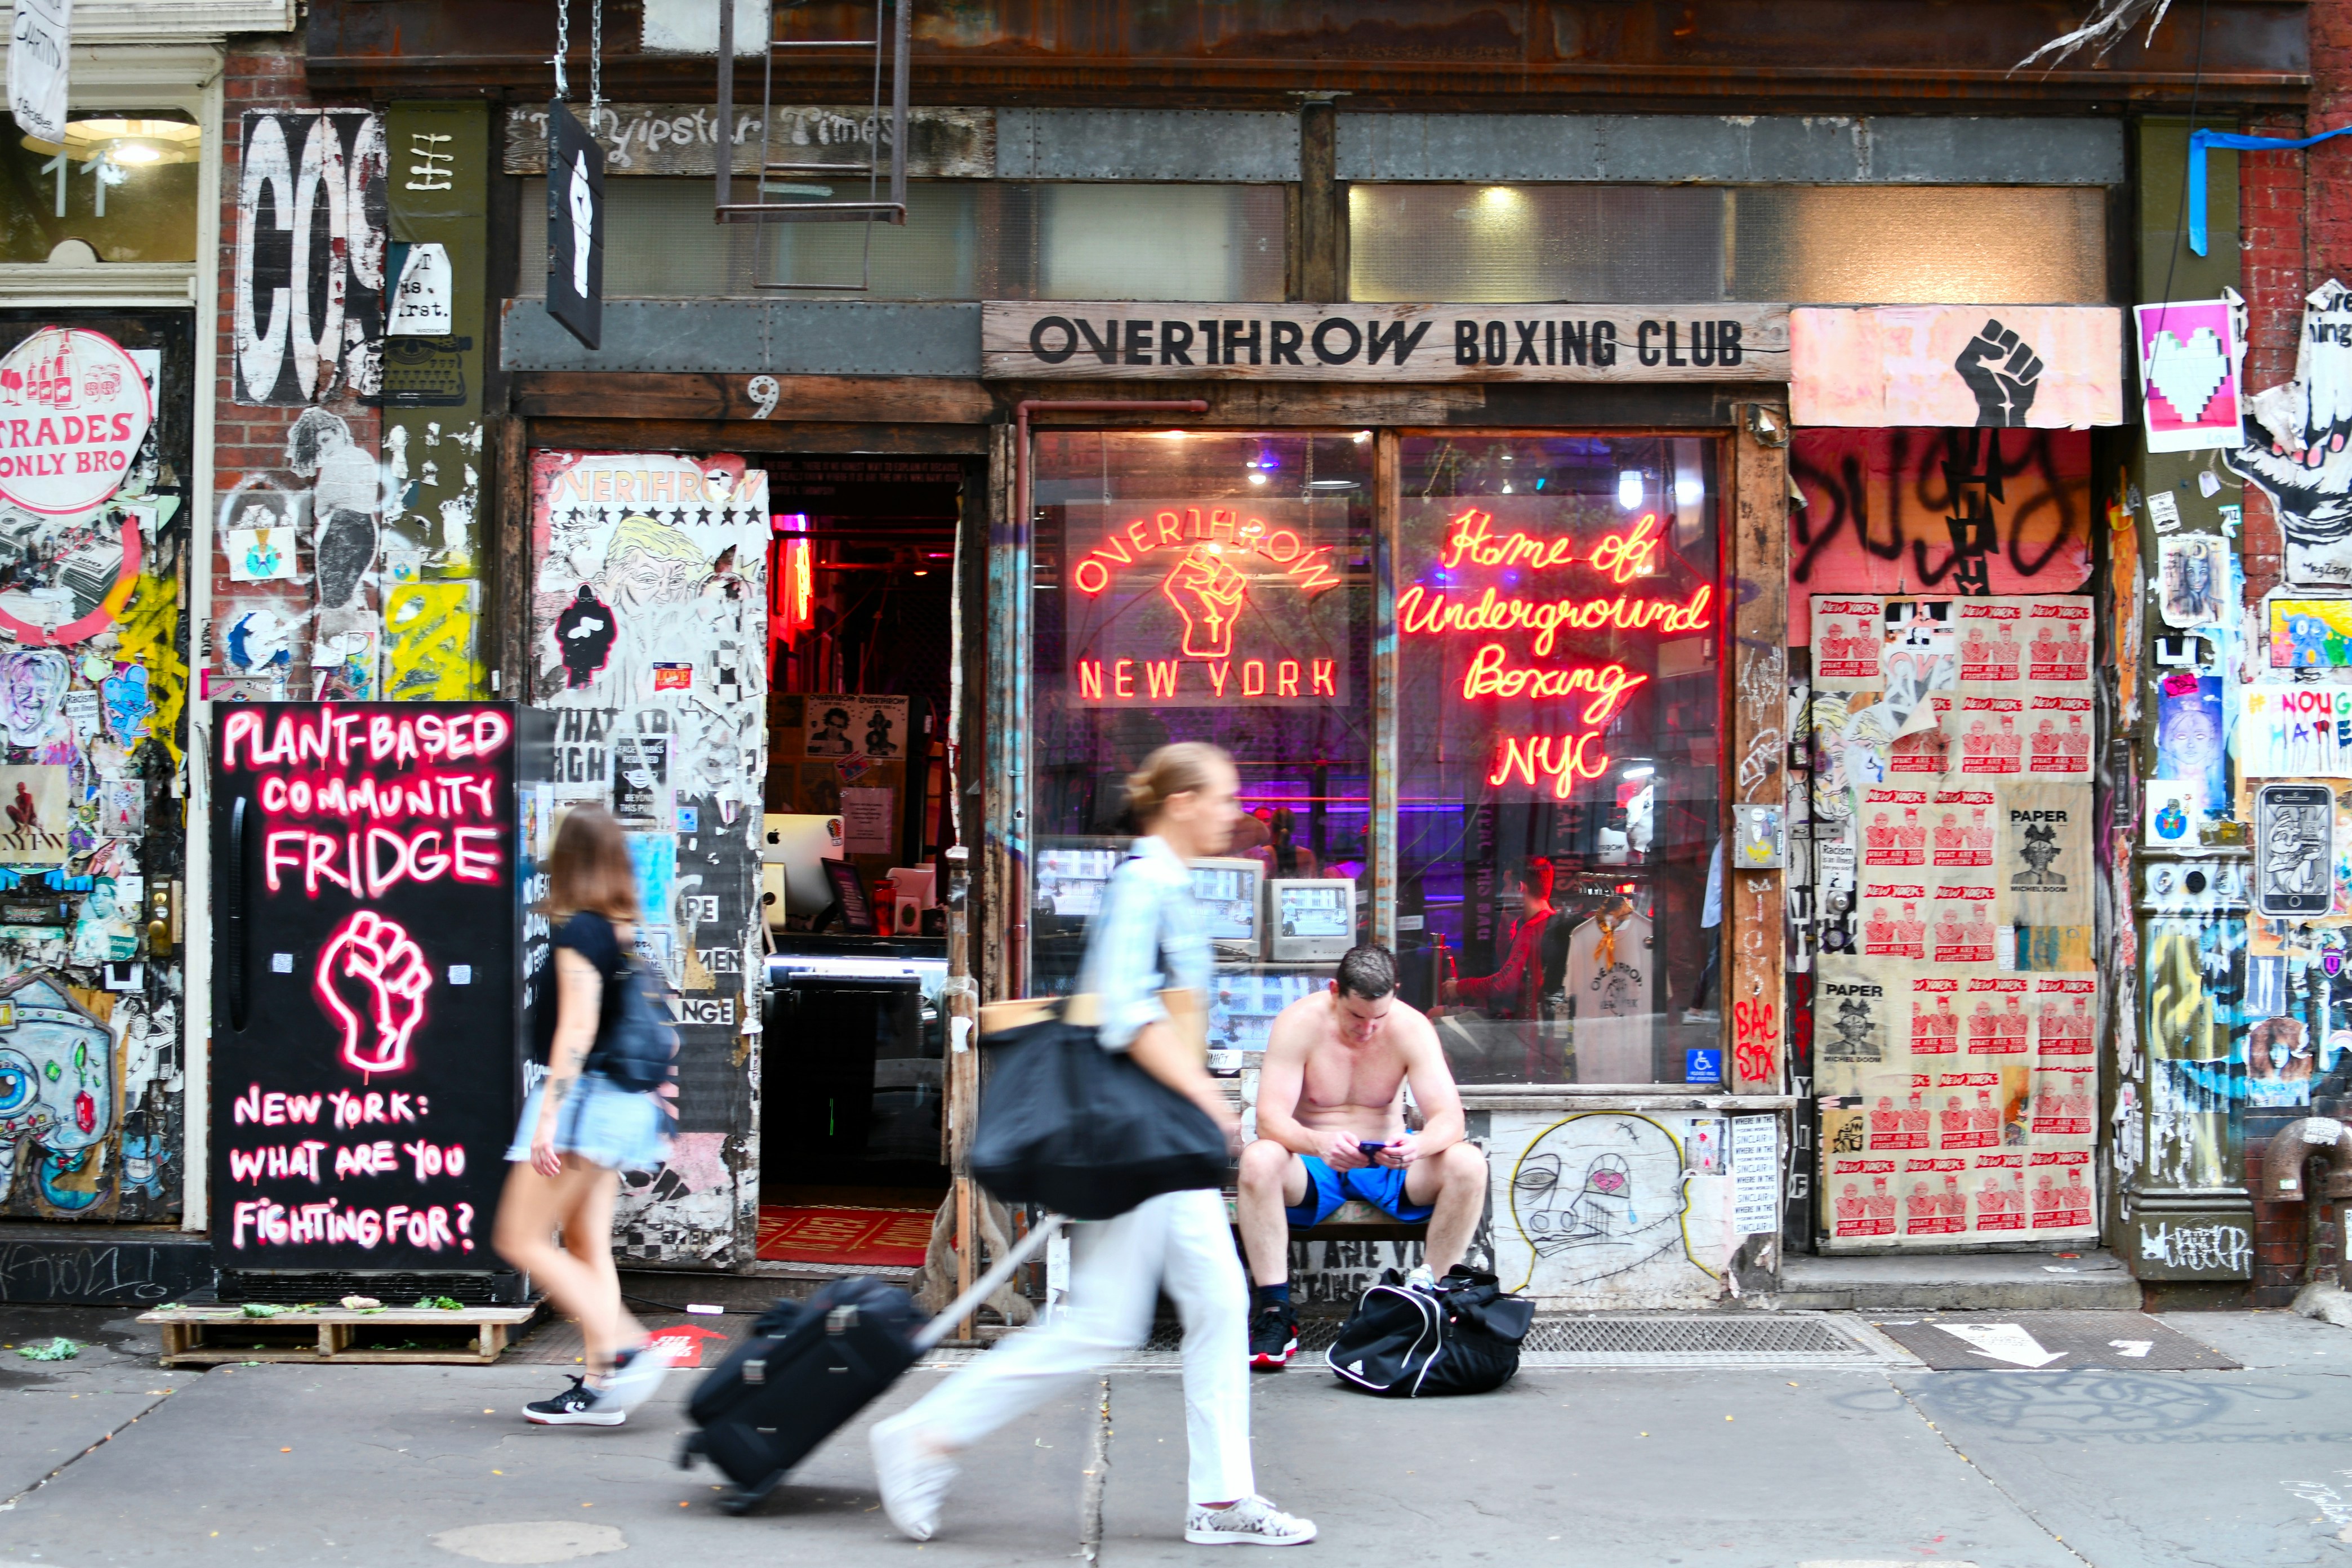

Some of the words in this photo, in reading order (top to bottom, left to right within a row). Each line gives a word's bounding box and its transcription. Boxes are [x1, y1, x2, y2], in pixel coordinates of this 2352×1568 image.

[1029, 315, 1434, 366] OVERTHROW
[1453, 319, 1618, 368] BOXING
[1637, 319, 1744, 368] CLUB
[747, 375, 779, 419] 9
[0, 452, 68, 478] ONLY
[75, 449, 127, 474] BRO
[1075, 508, 1342, 593] OVERTHROW
[1441, 508, 1573, 569] Home
[1589, 513, 1659, 584] of
[1397, 584, 1712, 657] Underground
[1820, 603, 1846, 613] NEW
[1847, 603, 1880, 614] YORK:
[1961, 607, 1988, 617] NEW
[1988, 607, 2021, 618] YORK:
[2030, 606, 2057, 617] NEW
[2056, 607, 2090, 618] YORK:
[1080, 660, 1178, 699] NEW
[1207, 660, 1336, 698] YORK
[1463, 643, 1649, 724] Boxing
[225, 708, 506, 765] PLANT-BASED
[1490, 731, 1609, 800] NYC
[263, 776, 493, 818] COMMUNITY
[2011, 810, 2068, 822] PAPER
[267, 827, 499, 898] FRIDGE
[1823, 845, 1853, 855] Racism
[1826, 983, 1883, 997] PAPER
[1735, 1043, 1775, 1083] SIX
[234, 1084, 322, 1125] NEW
[329, 1088, 429, 1130] YORK:
[1735, 1117, 1754, 1126] WHERE
[230, 1139, 328, 1184] WHAT
[335, 1141, 399, 1180] ARE
[403, 1138, 466, 1182] YOU
[1736, 1146, 1754, 1155] WHERE
[1737, 1175, 1755, 1184] WHERE
[232, 1197, 383, 1249] FIGHTING
[386, 1202, 475, 1251] FOR?
[1735, 1206, 1754, 1214] WHERE
